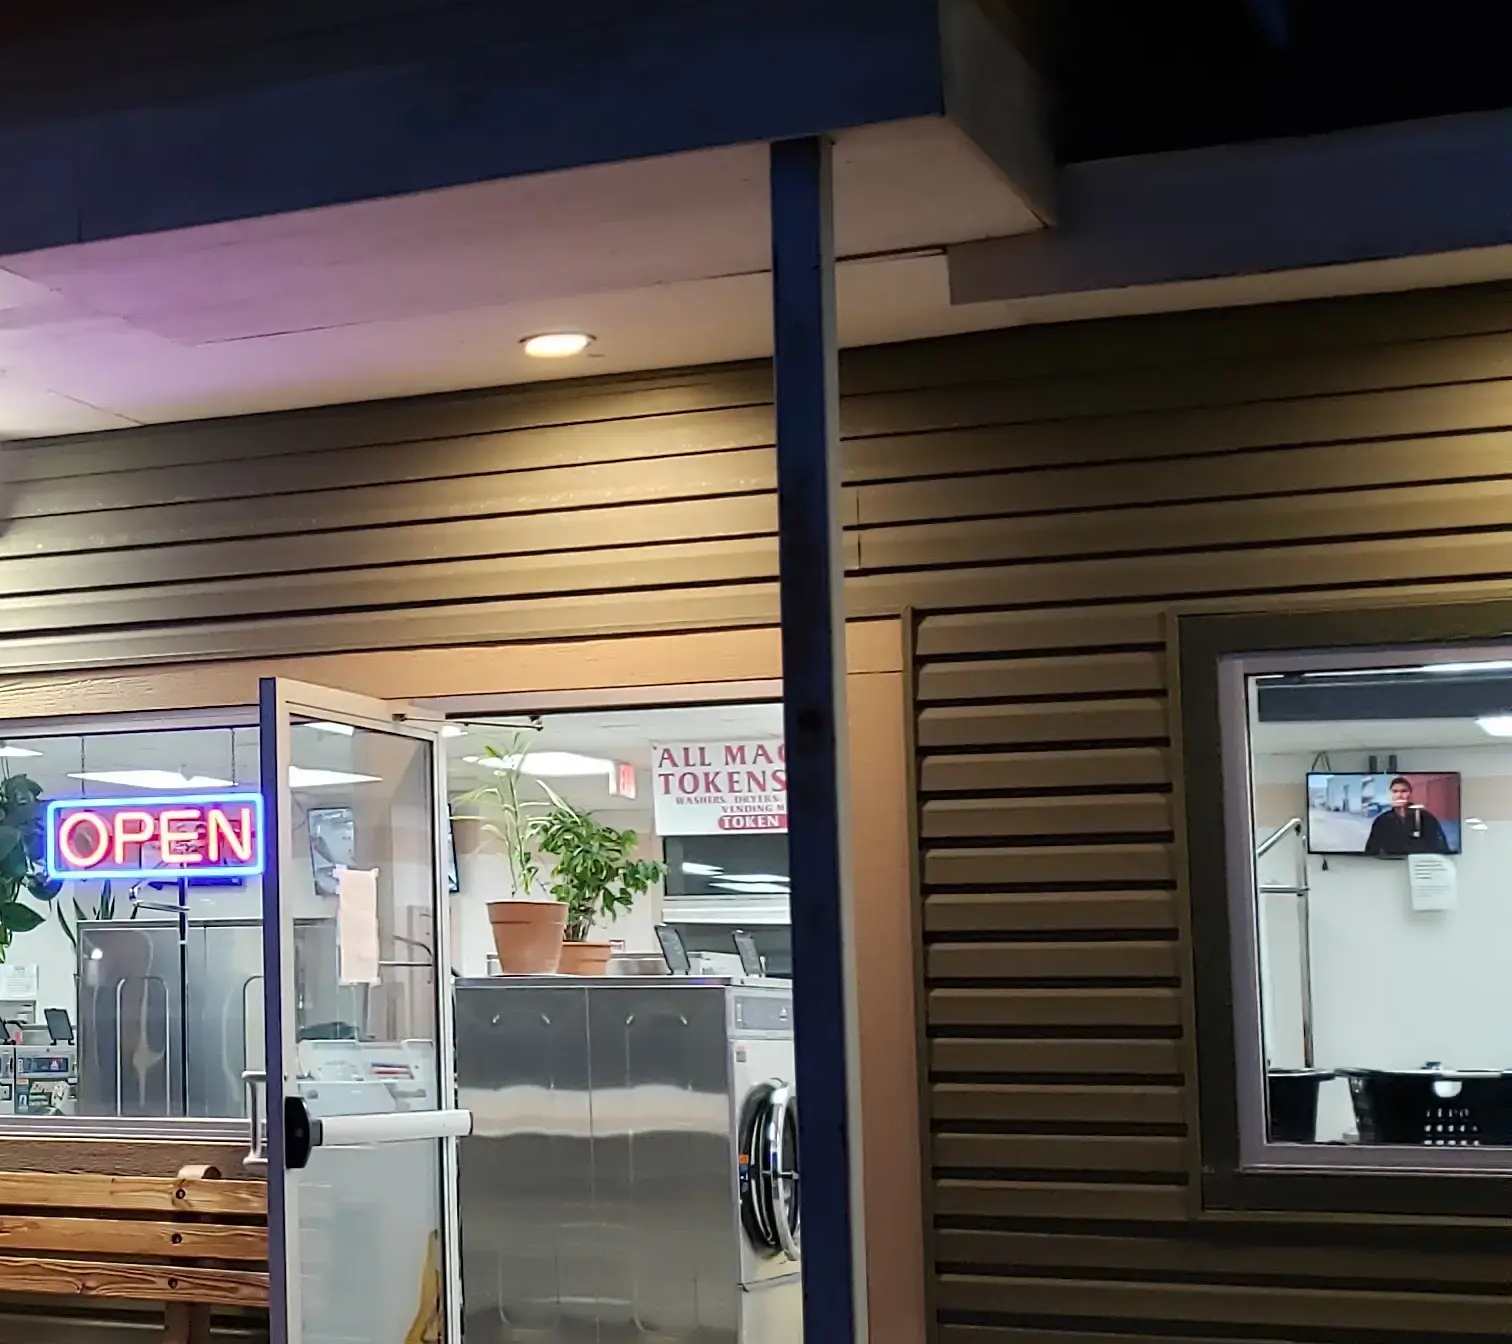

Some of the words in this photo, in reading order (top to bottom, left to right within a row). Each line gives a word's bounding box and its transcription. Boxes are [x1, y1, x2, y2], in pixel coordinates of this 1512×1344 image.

[658, 746, 711, 768] ALL
[658, 769, 788, 795] TOKENS
[721, 805, 773, 814] VENDING
[722, 815, 780, 829] TOKEN
[59, 807, 252, 868] OPEN
